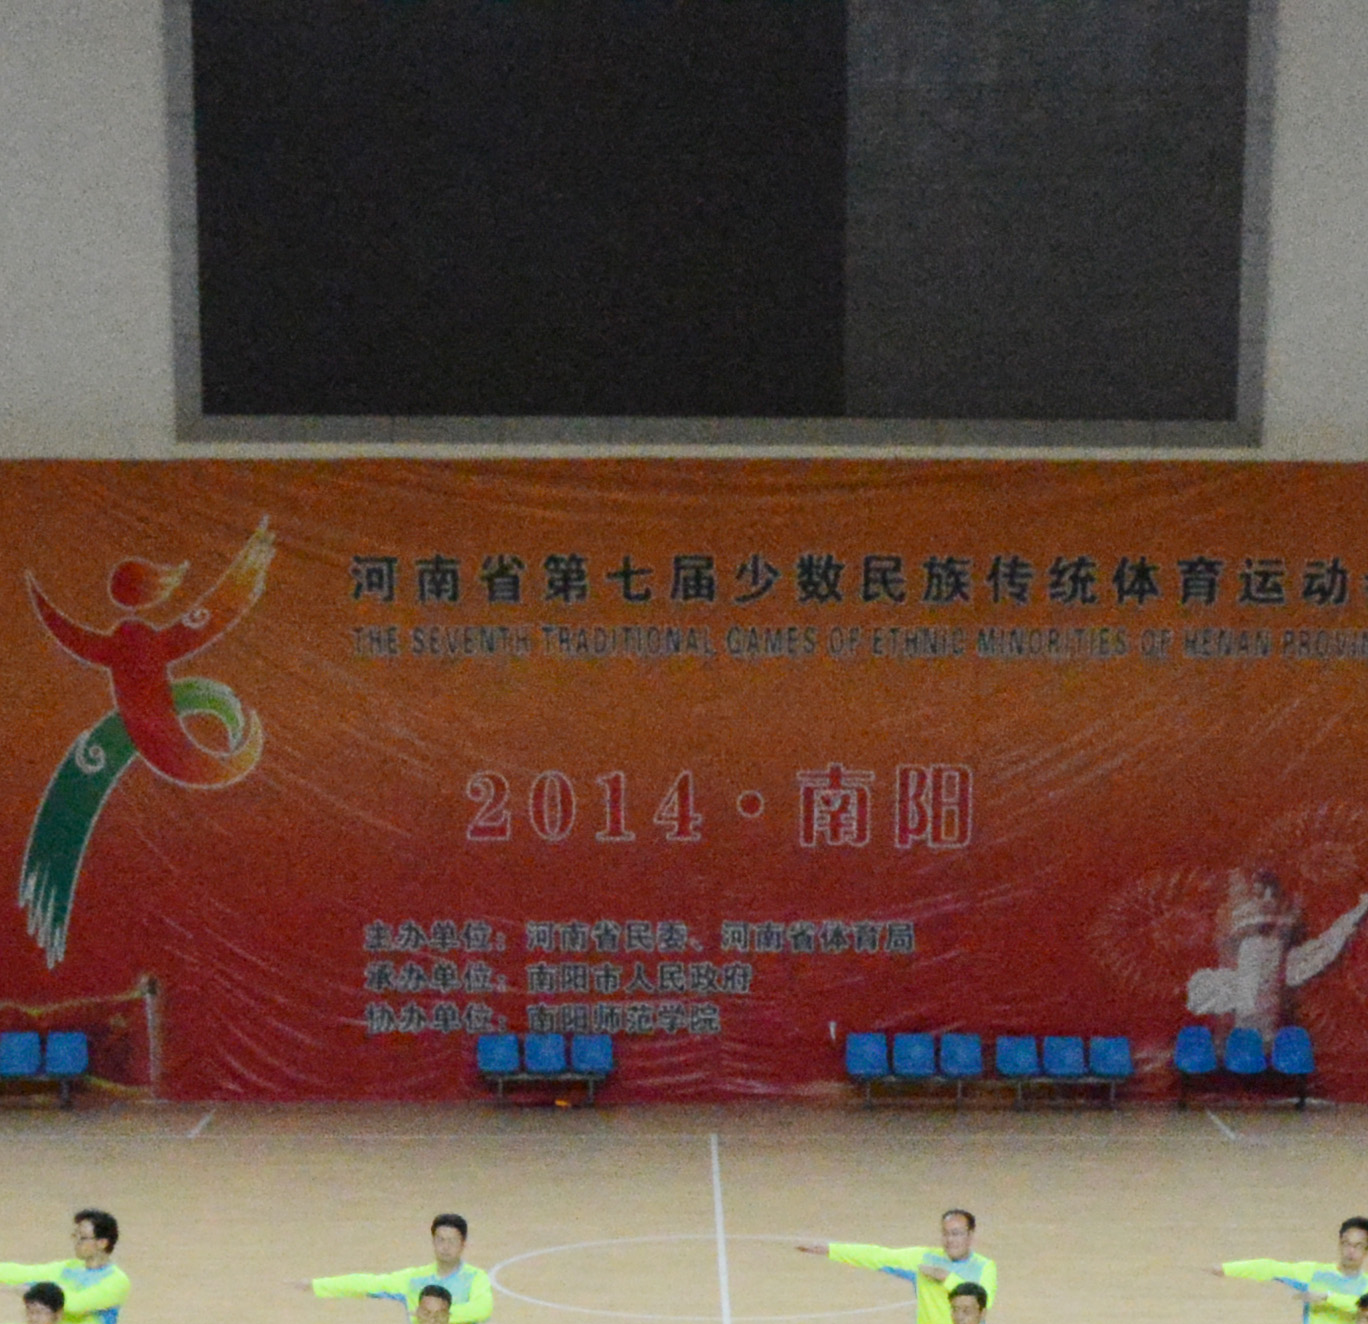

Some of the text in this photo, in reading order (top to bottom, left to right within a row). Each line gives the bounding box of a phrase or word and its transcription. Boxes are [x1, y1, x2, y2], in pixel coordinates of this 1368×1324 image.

[352, 626, 399, 656] THE
[411, 626, 531, 656] SEVENTH
[542, 626, 713, 657] TRADITIONAL
[726, 626, 817, 657] GAMES
[829, 627, 859, 657] OF
[871, 628, 965, 658] ETHNIC
[977, 628, 1129, 659] MINORITIES
[1140, 629, 1172, 659] OF
[1183, 629, 1273, 659] HENAN
